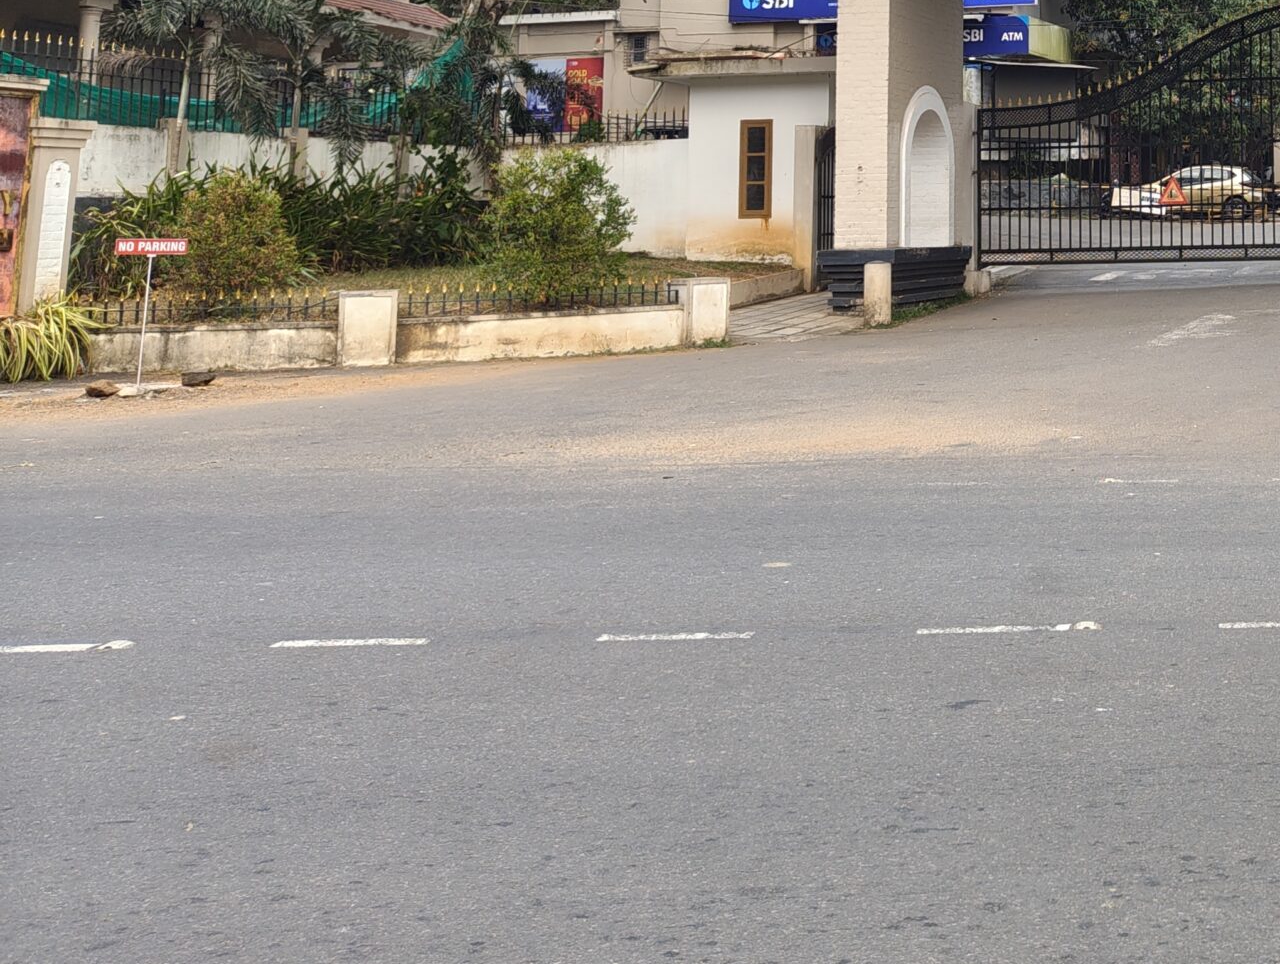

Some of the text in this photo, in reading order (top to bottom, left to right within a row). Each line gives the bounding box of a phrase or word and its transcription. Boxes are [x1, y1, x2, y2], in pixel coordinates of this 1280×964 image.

[963, 28, 984, 42] SBI
[1001, 31, 1024, 42] ATM
[118, 241, 186, 252] NO PARKING
